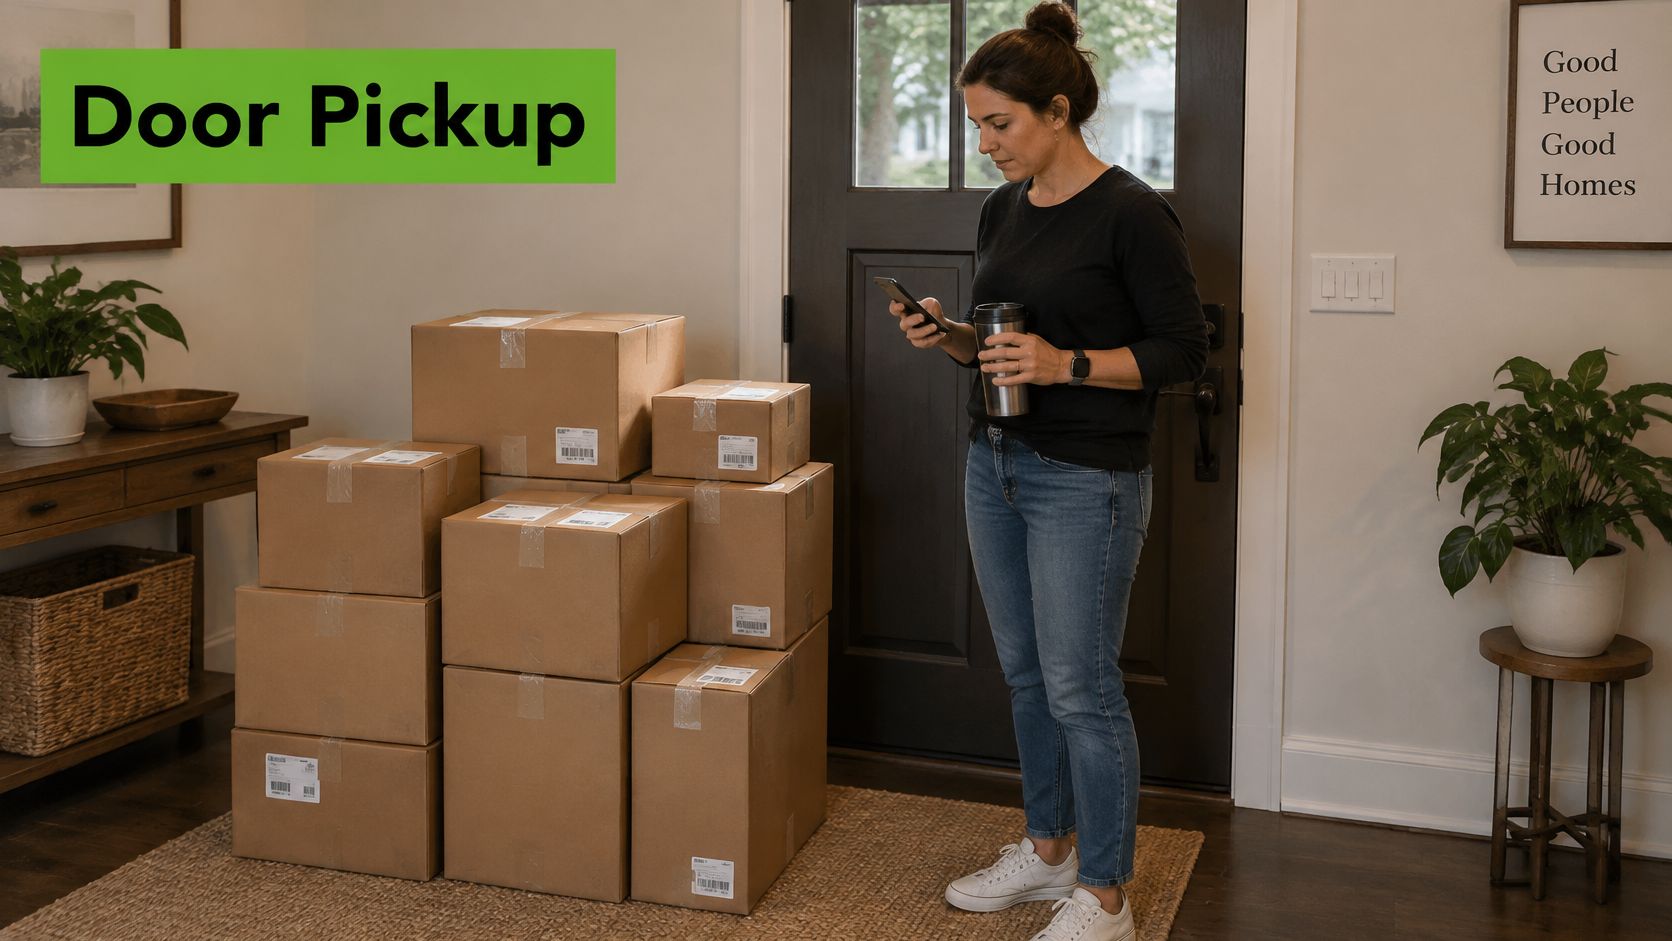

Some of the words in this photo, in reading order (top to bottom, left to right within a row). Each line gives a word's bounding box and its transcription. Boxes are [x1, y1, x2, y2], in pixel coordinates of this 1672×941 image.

[1543, 48, 1618, 74] Good
[1542, 89, 1635, 120] People
[1541, 131, 1616, 156] Good
[1540, 173, 1636, 196] Homes
